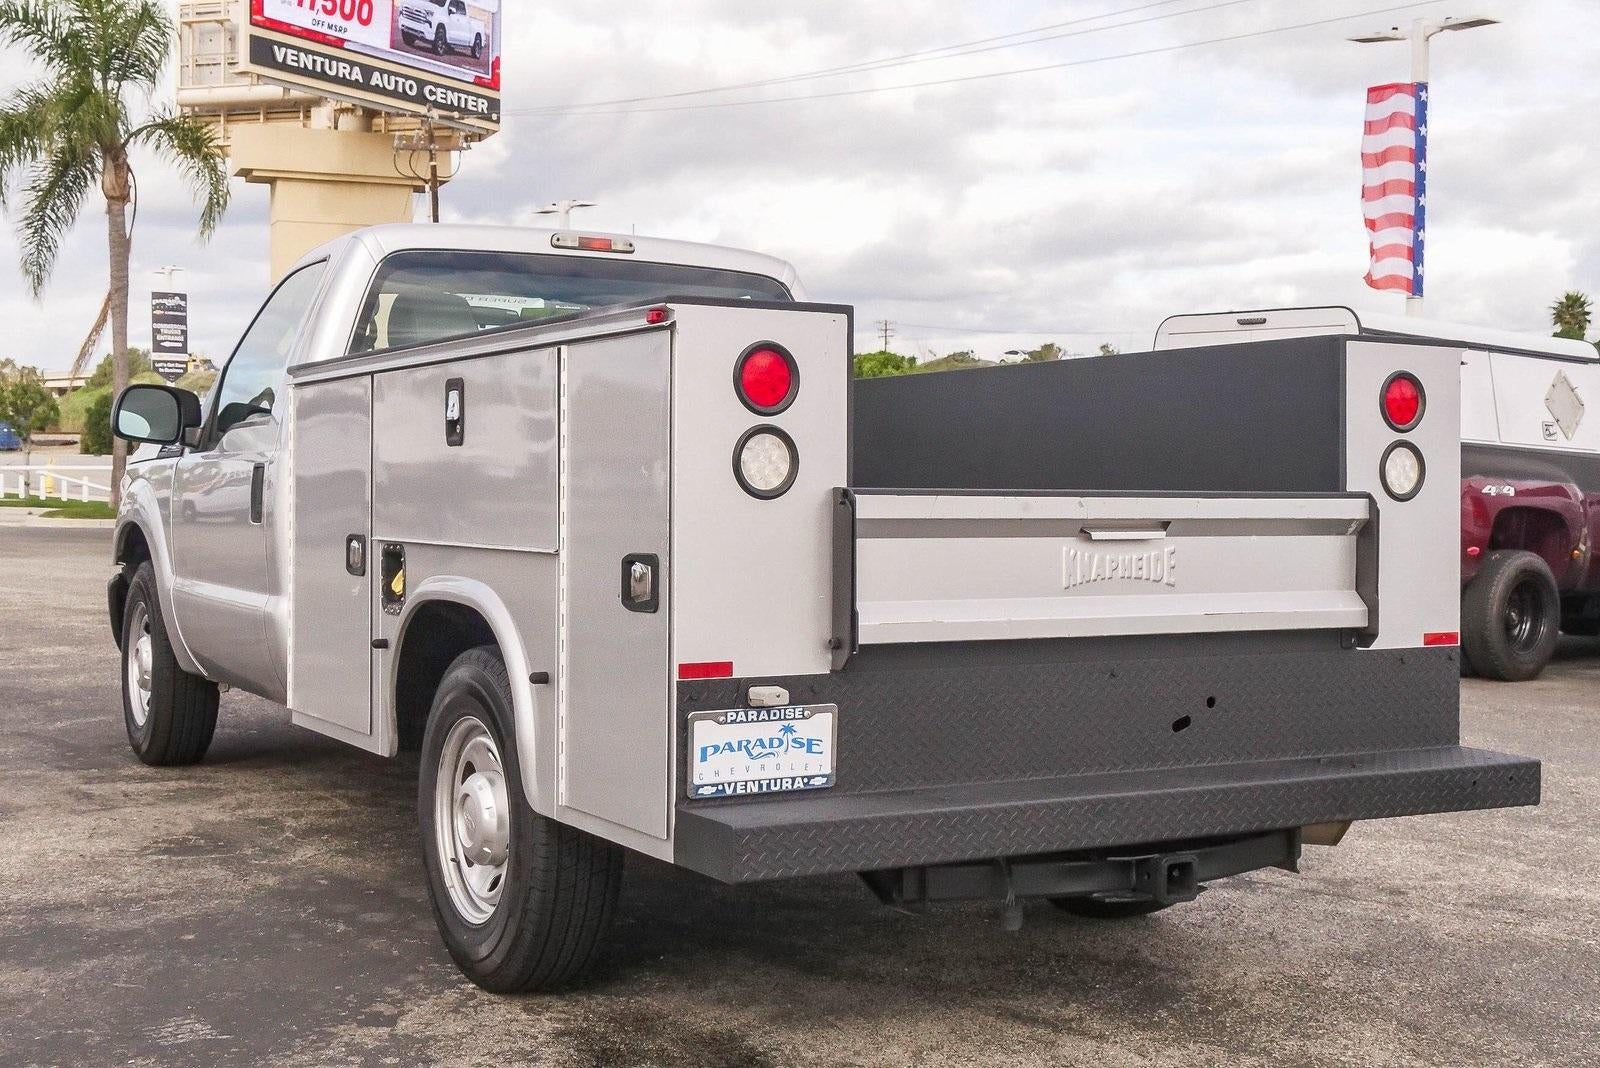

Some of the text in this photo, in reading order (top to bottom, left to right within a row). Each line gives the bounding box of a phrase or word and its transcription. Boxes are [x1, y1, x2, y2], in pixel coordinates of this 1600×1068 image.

[297, 0, 374, 26] ,500
[311, 18, 348, 34] OFF MSRP
[272, 45, 489, 114] VENTURA AUTO CENTER
[1062, 546, 1176, 590] KNAPHEIDE
[727, 708, 805, 723] PARADISE
[699, 723, 824, 763] PARADISE
[698, 763, 824, 781] CHEVROLET
[723, 777, 805, 795] VENTURA
